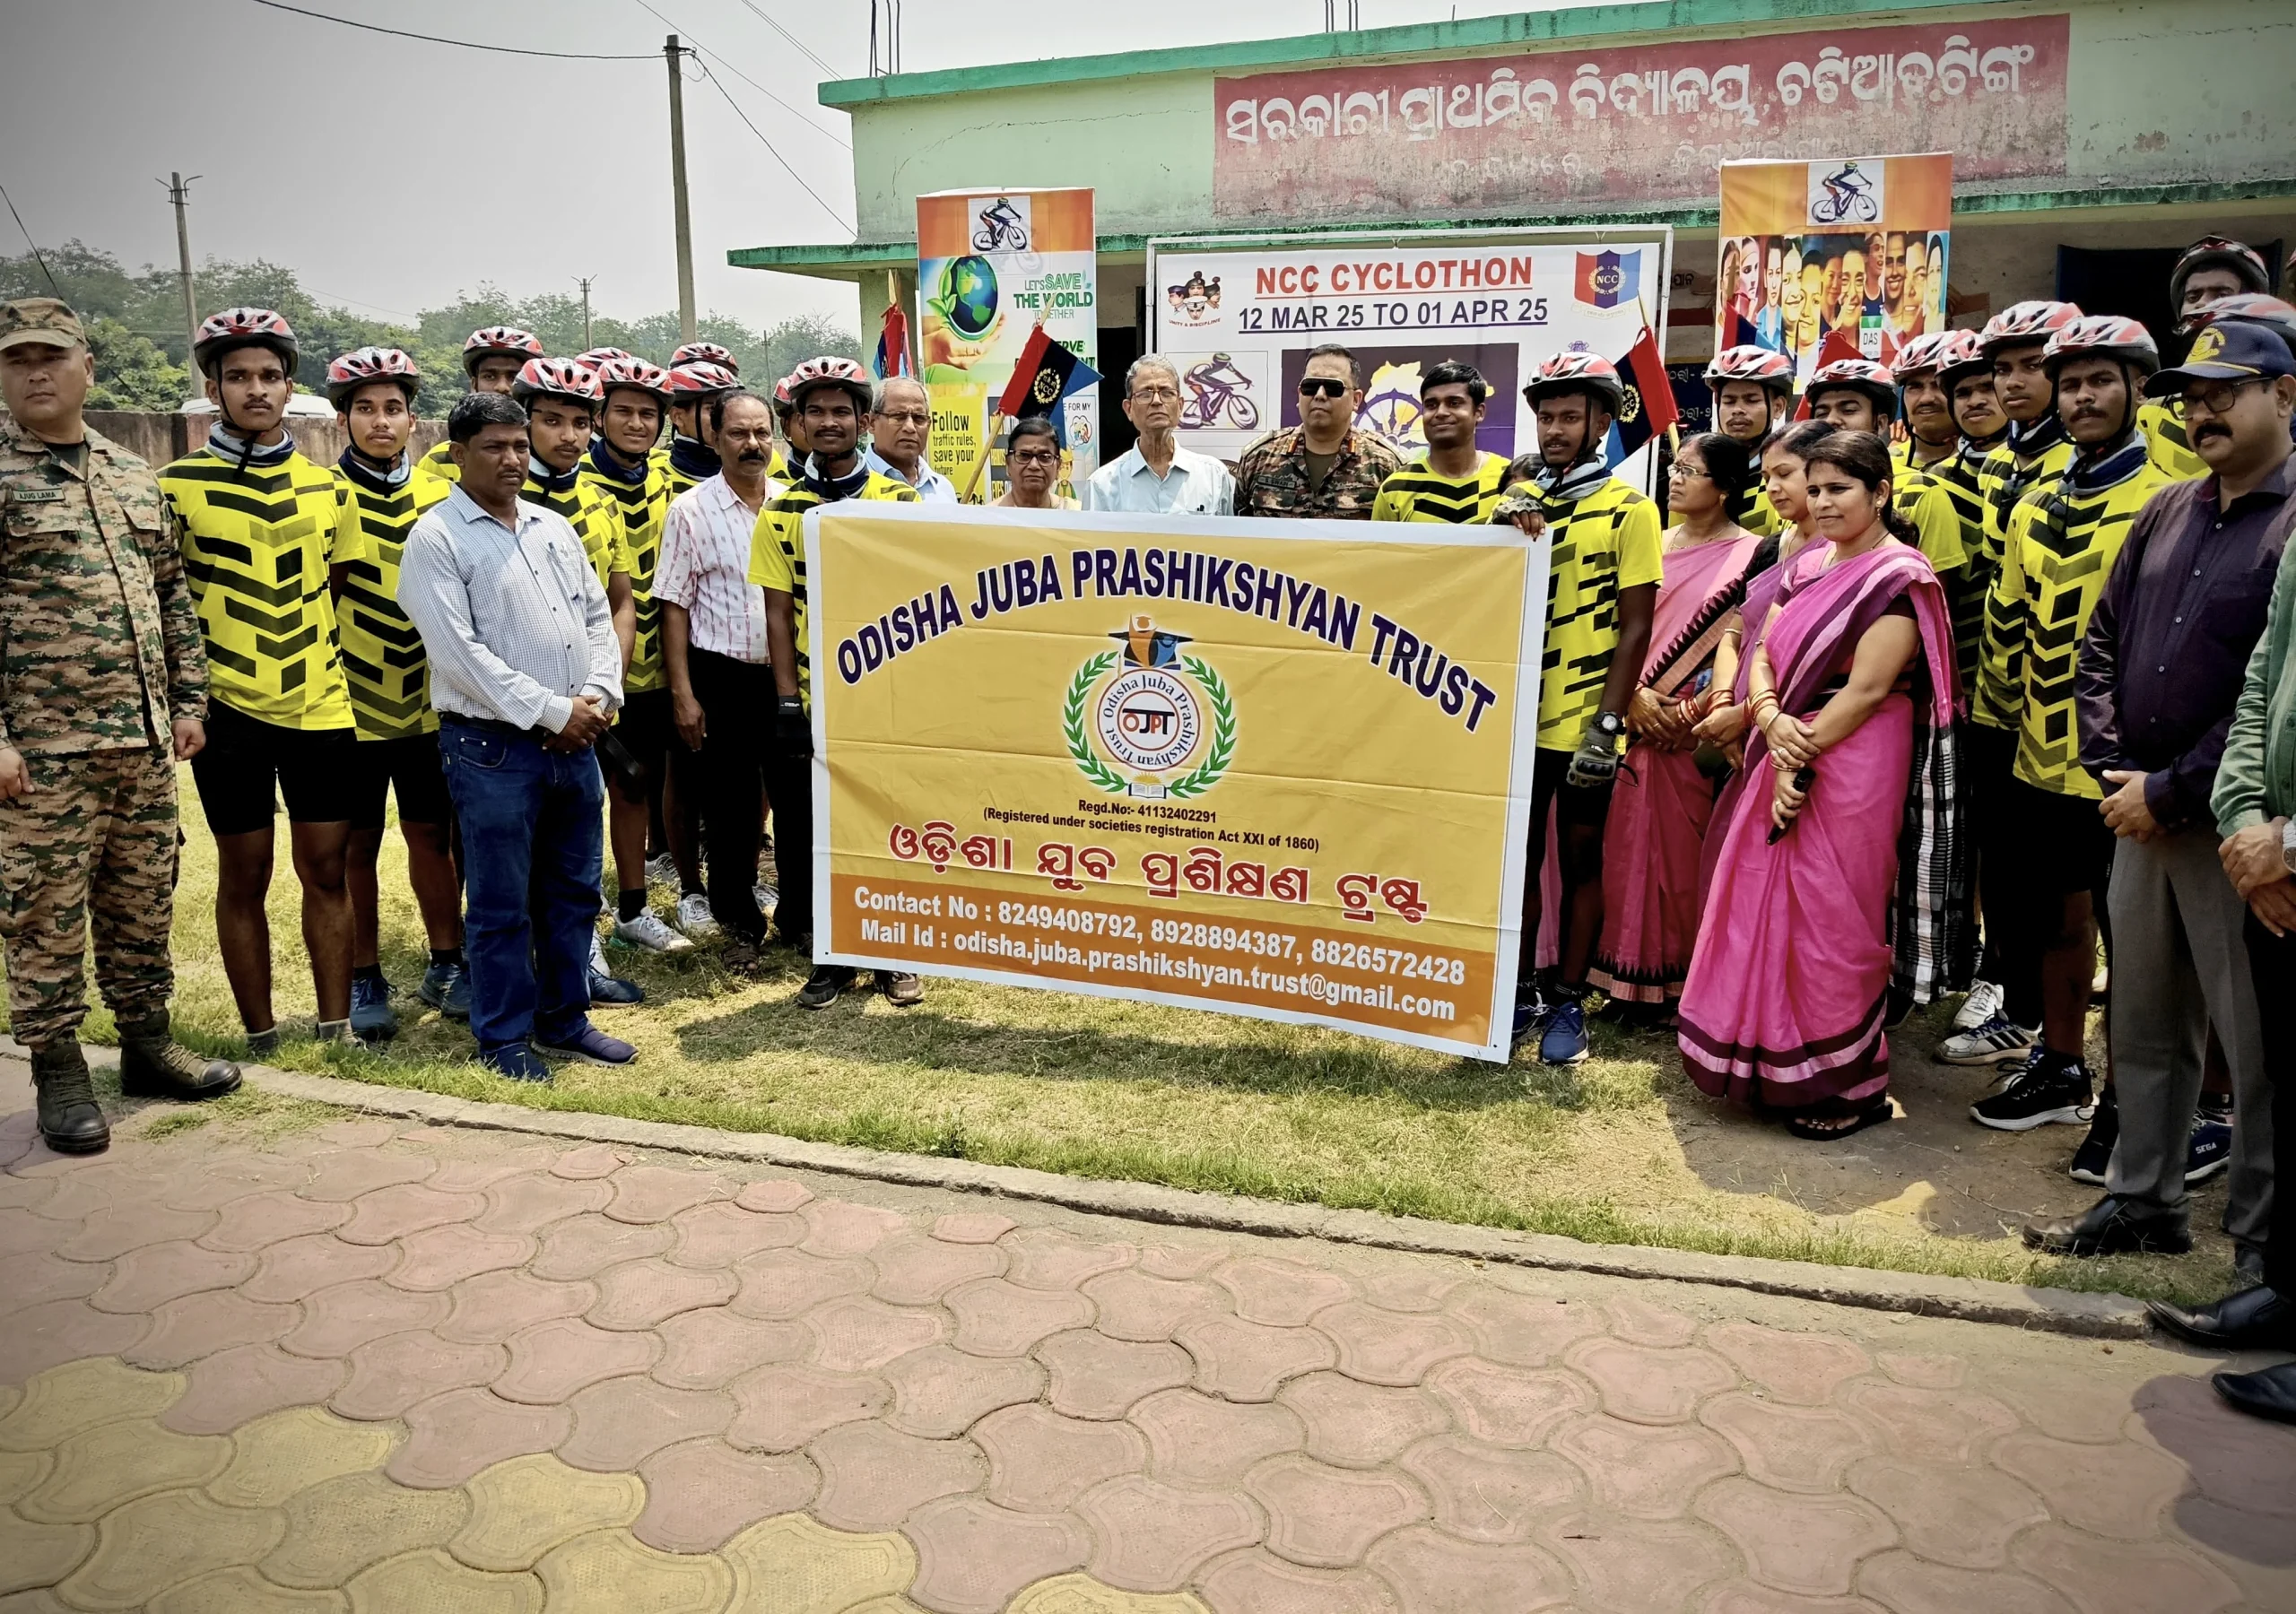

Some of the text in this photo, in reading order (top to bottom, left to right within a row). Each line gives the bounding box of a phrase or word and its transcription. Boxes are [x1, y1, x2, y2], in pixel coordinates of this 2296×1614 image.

[1045, 273, 1082, 291] SAVE
[1256, 256, 1532, 295] NCC CYCLOTHON
[1596, 274, 1619, 284] NCC
[1013, 293, 1039, 308] THE
[1169, 319, 1184, 327] UNITY
[1189, 317, 1221, 327] DISCIPLINE
[1239, 298, 1548, 330] 12 MAR 25 TO 01 APR 25
[1863, 332, 1878, 345] DAS
[1039, 381, 1053, 395] NCC
[1082, 403, 1091, 411] MY
[932, 411, 970, 431] Follow
[933, 434, 977, 447] traffic rules,
[934, 449, 975, 465] save your
[37, 491, 57, 499] LAMA
[837, 548, 1498, 733] ODISHA JUBA PRASHIKSHYAN TRUST
[1103, 674, 1196, 766] Odisha Juba Prashikshyan Trust
[1078, 799, 1217, 824] Regd.No:- 41132402291
[983, 806, 1320, 854] (Registered under societies registration Act XXI of 1860)
[889, 820, 1013, 874] ଓଡ଼ିଶା
[1036, 841, 1117, 892] ଯୁବ
[1141, 846, 1309, 898] ପ୍ରଶିକ୍ଷଣ
[855, 886, 941, 916] Contact
[948, 895, 978, 920] No
[998, 900, 1144, 944] 8249408792,
[1151, 918, 1302, 966] 8928894387,
[1311, 939, 1465, 985] 8826572428
[861, 918, 906, 944] Mail
[914, 924, 934, 948] Id
[953, 930, 1455, 1020] odisha.juba.prashikshyan.trust@gmail.com
[2196, 1141, 2217, 1155] SEGA
